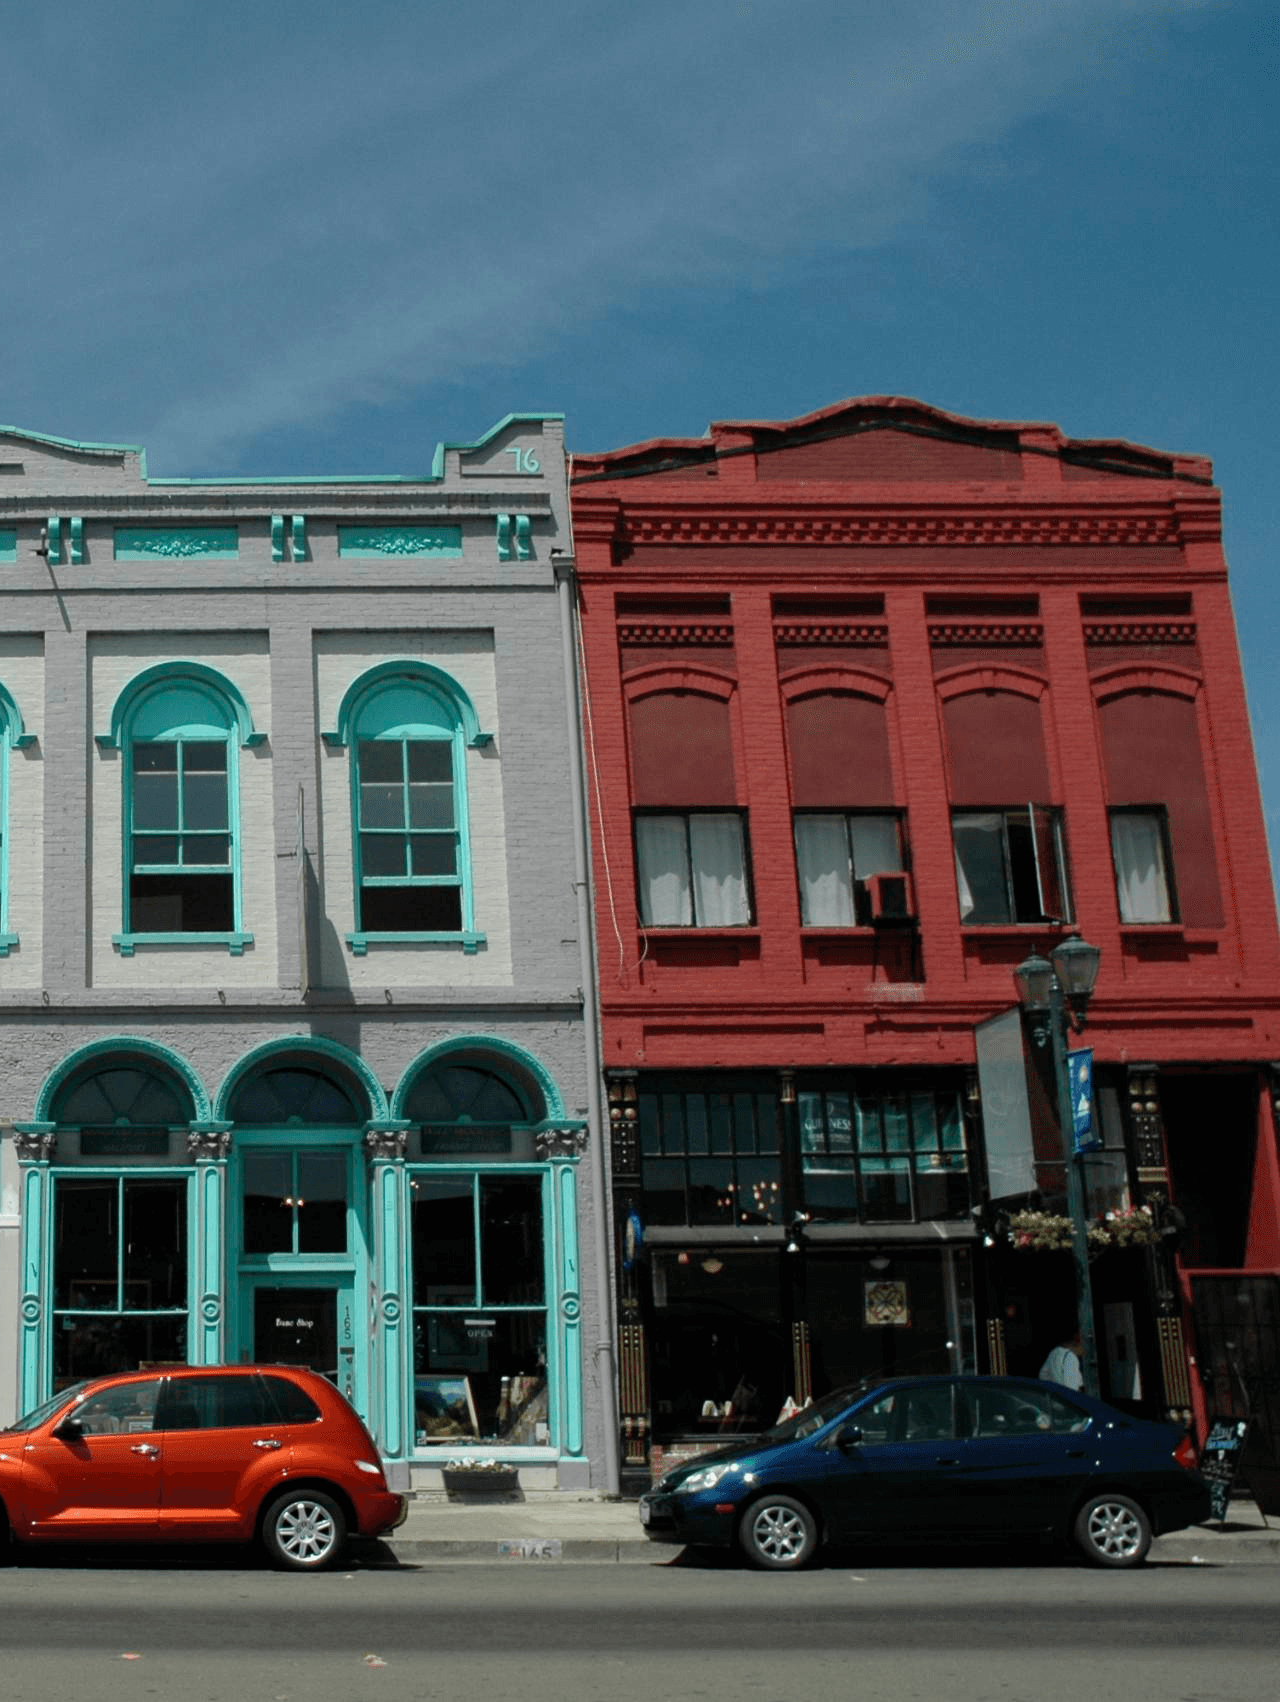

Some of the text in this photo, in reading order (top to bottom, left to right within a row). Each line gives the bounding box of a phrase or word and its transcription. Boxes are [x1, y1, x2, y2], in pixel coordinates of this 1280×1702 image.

[504, 447, 540, 473] 76
[343, 1305, 352, 1340] 165
[467, 1328, 493, 1338] OPEN
